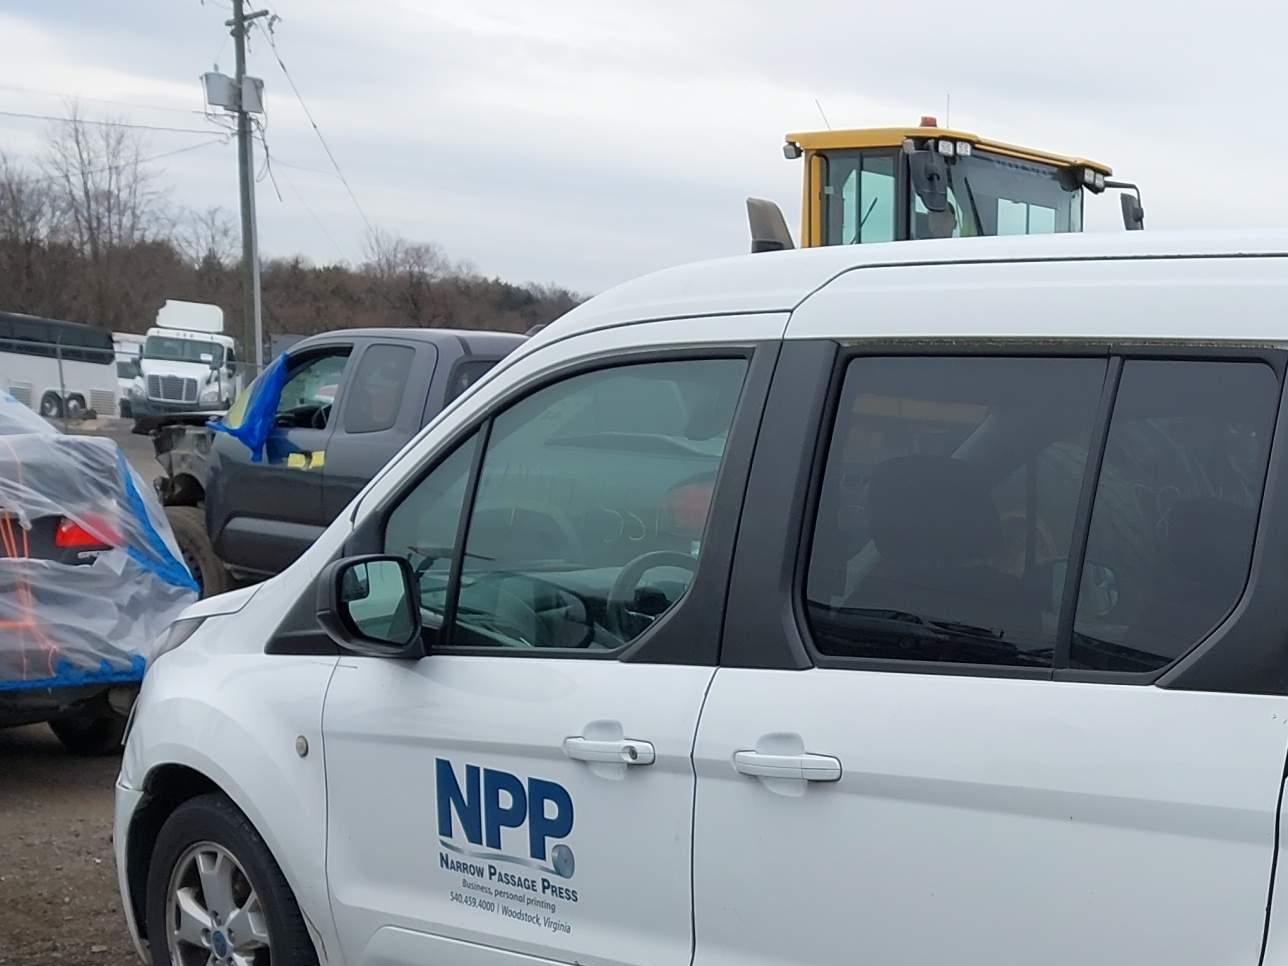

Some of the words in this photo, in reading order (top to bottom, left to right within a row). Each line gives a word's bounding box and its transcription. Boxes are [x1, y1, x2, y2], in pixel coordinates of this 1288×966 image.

[435, 758, 574, 861] NPP
[439, 852, 484, 878] NARROW
[488, 865, 538, 892] PASSAGE
[541, 878, 578, 902] PRESS
[462, 879, 493, 896] Business,
[494, 887, 525, 902] personal
[526, 895, 556, 914] printing
[450, 891, 495, 913] 540.459.4000
[501, 904, 542, 927] Woodstock,
[543, 916, 571, 934] Virginia
